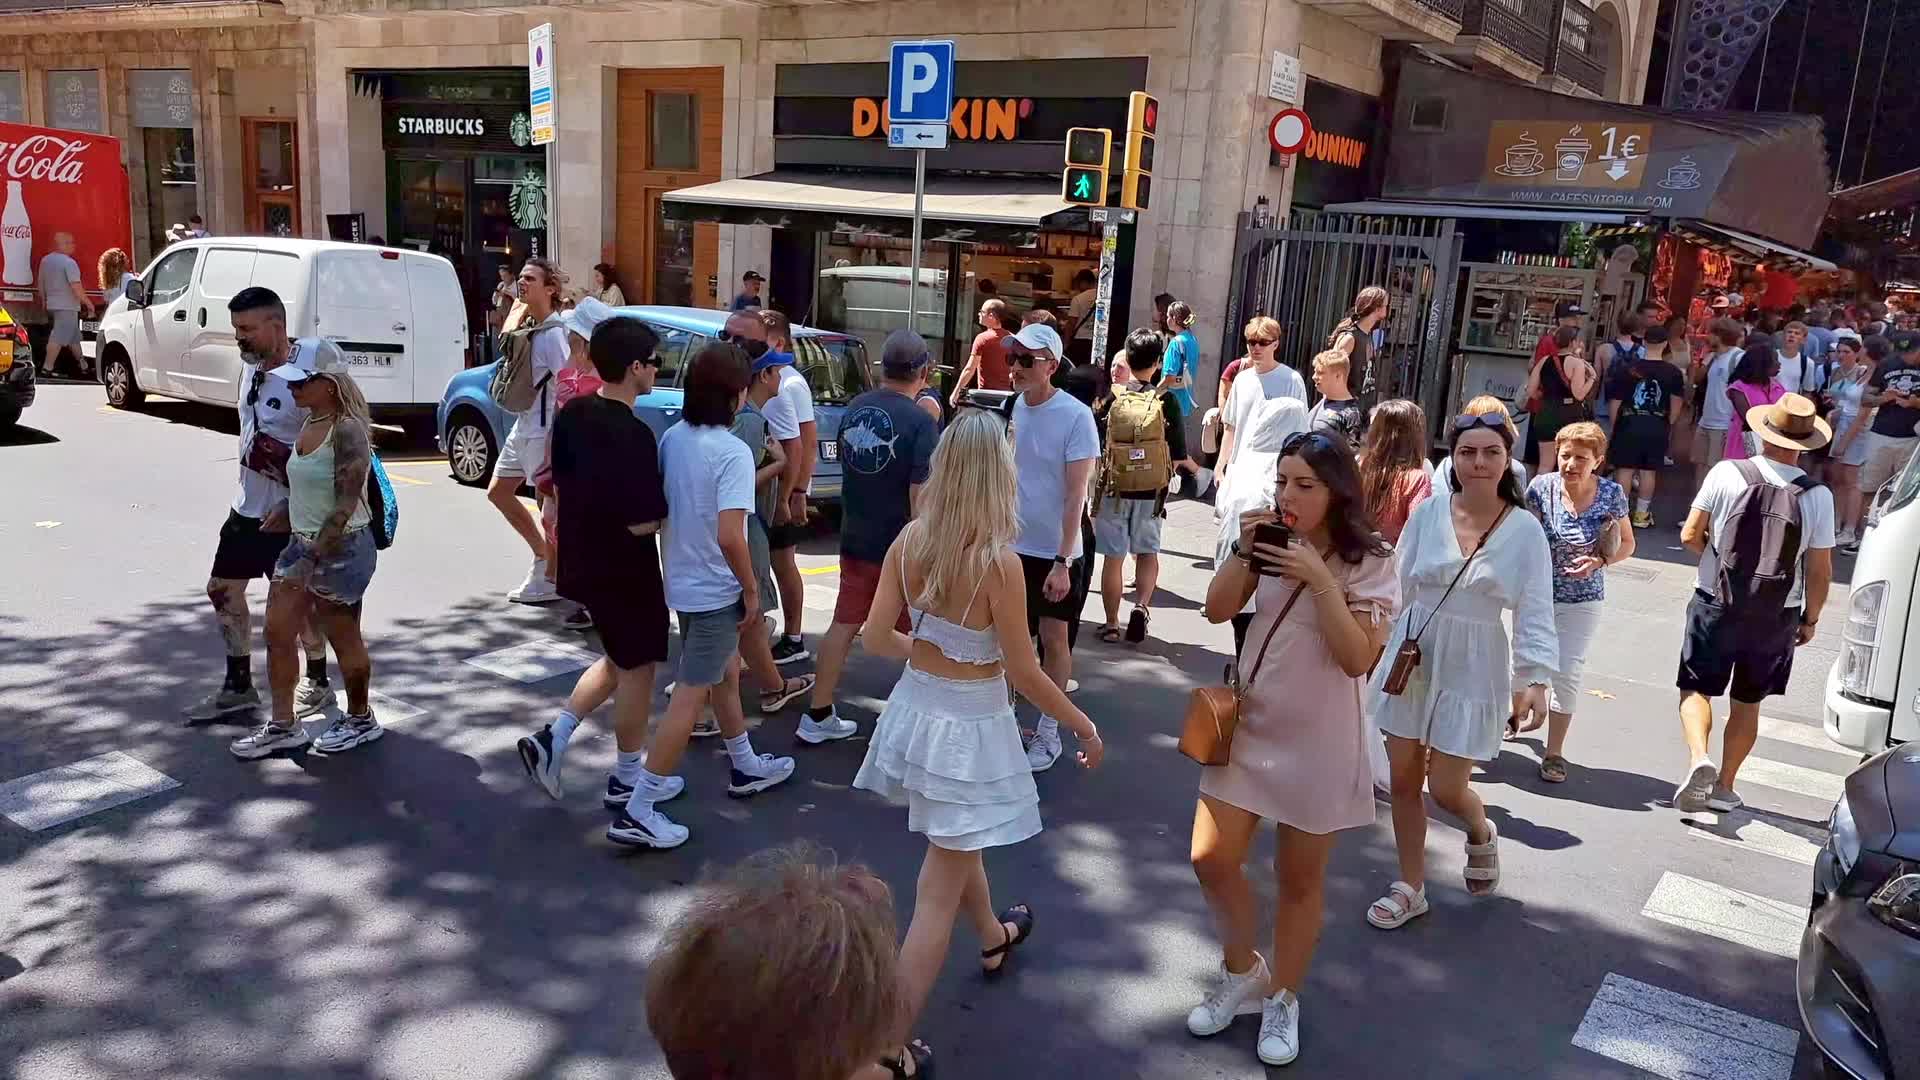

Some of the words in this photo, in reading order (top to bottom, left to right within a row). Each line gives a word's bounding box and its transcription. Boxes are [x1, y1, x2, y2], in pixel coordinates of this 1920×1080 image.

[901, 52, 938, 112] P
[399, 117, 484, 136] STARBUCKS
[852, 98, 1033, 140] DKIN'
[1598, 127, 1641, 160] 1€
[347, 355, 369, 365] 363
